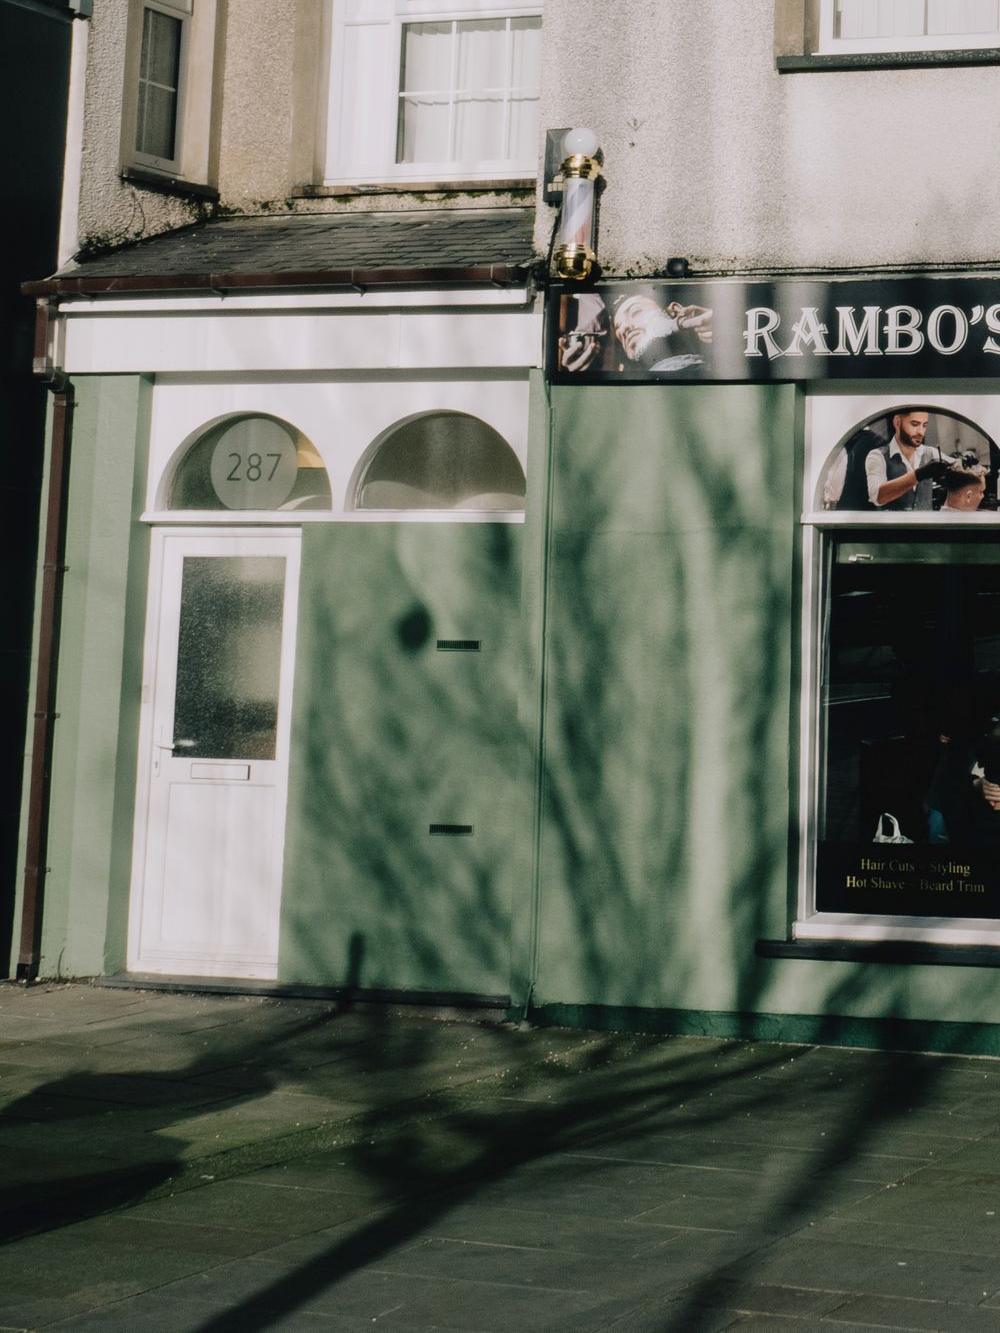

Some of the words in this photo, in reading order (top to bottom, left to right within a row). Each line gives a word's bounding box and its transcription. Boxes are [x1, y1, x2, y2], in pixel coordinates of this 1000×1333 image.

[225, 452, 282, 482] 287
[860, 858, 886, 871] Hair
[888, 859, 916, 872] Cuts
[930, 860, 971, 877] Styling
[846, 875, 867, 888] Hot
[871, 876, 905, 889] Shave
[920, 878, 954, 891] Beard
[957, 880, 985, 893] Trim
